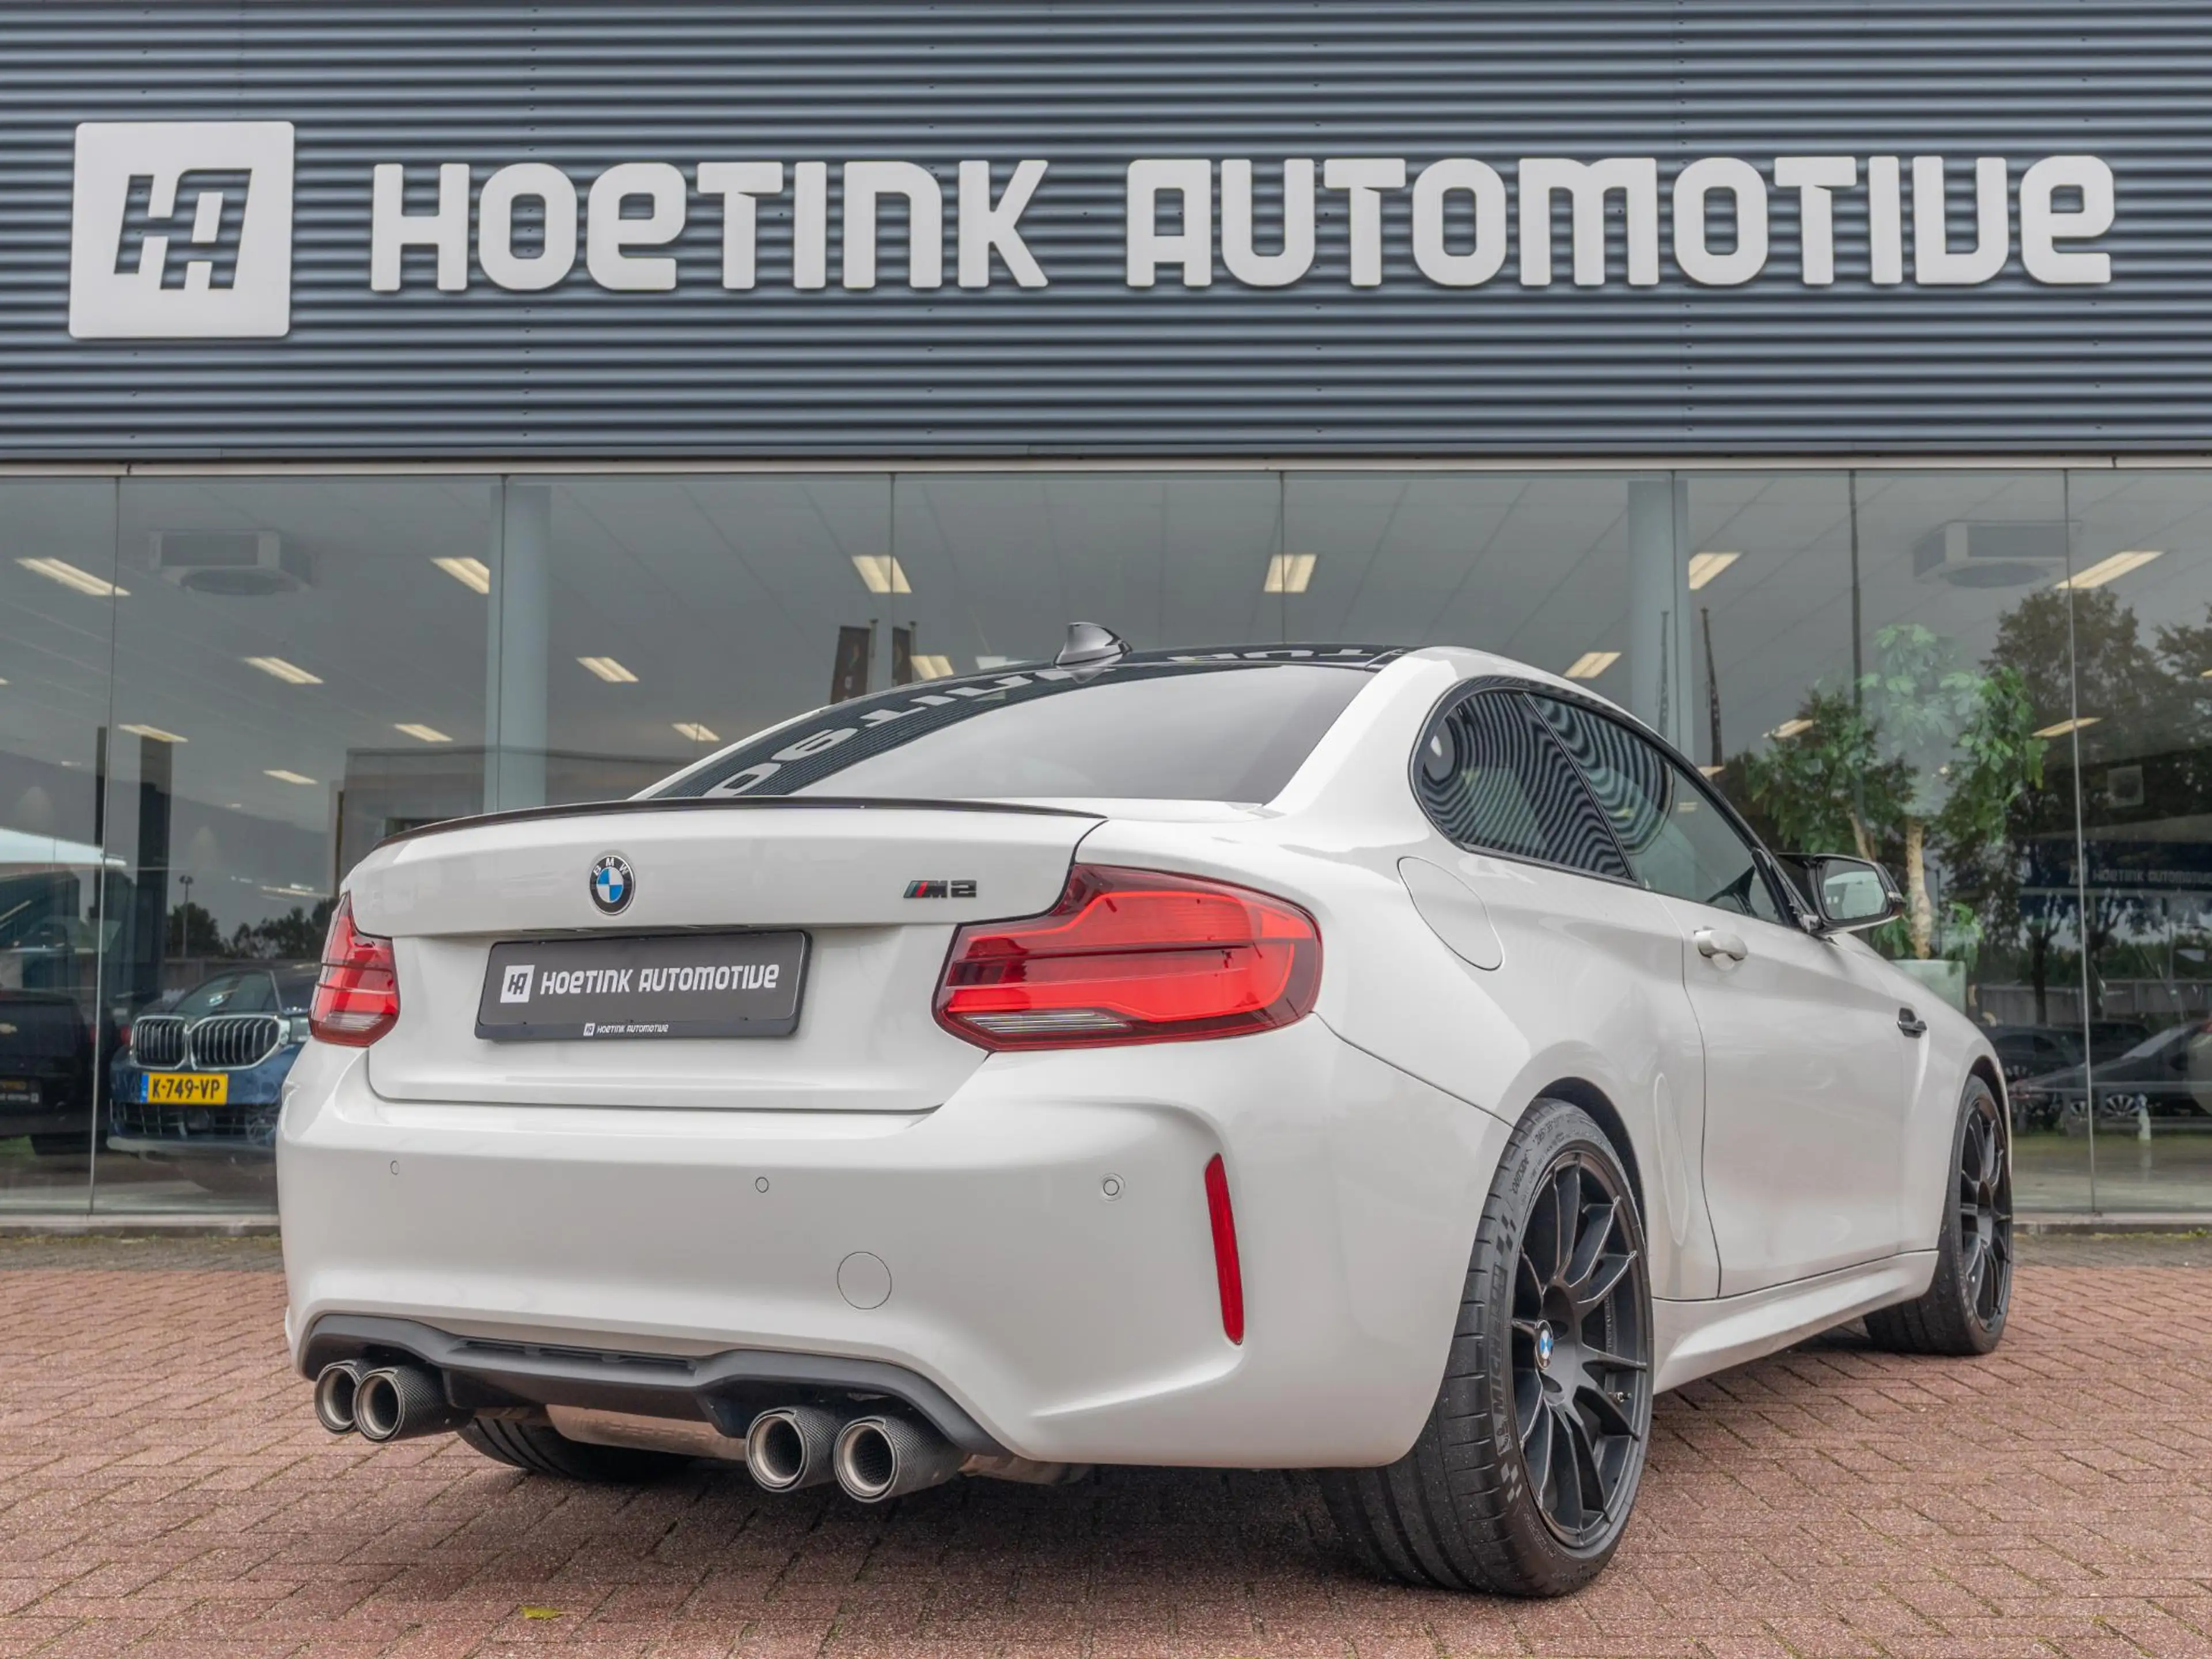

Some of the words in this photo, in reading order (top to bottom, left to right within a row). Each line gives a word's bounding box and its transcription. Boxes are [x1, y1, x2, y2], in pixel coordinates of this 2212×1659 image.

[370, 160, 1048, 292] HOETINK
[1126, 155, 2115, 287] AUTOMOTIVE
[593, 858, 630, 876] BMW
[540, 968, 633, 995] HOETINK
[638, 964, 779, 993] AUTOMOTIVE
[152, 1078, 220, 1099] K-749-VP
